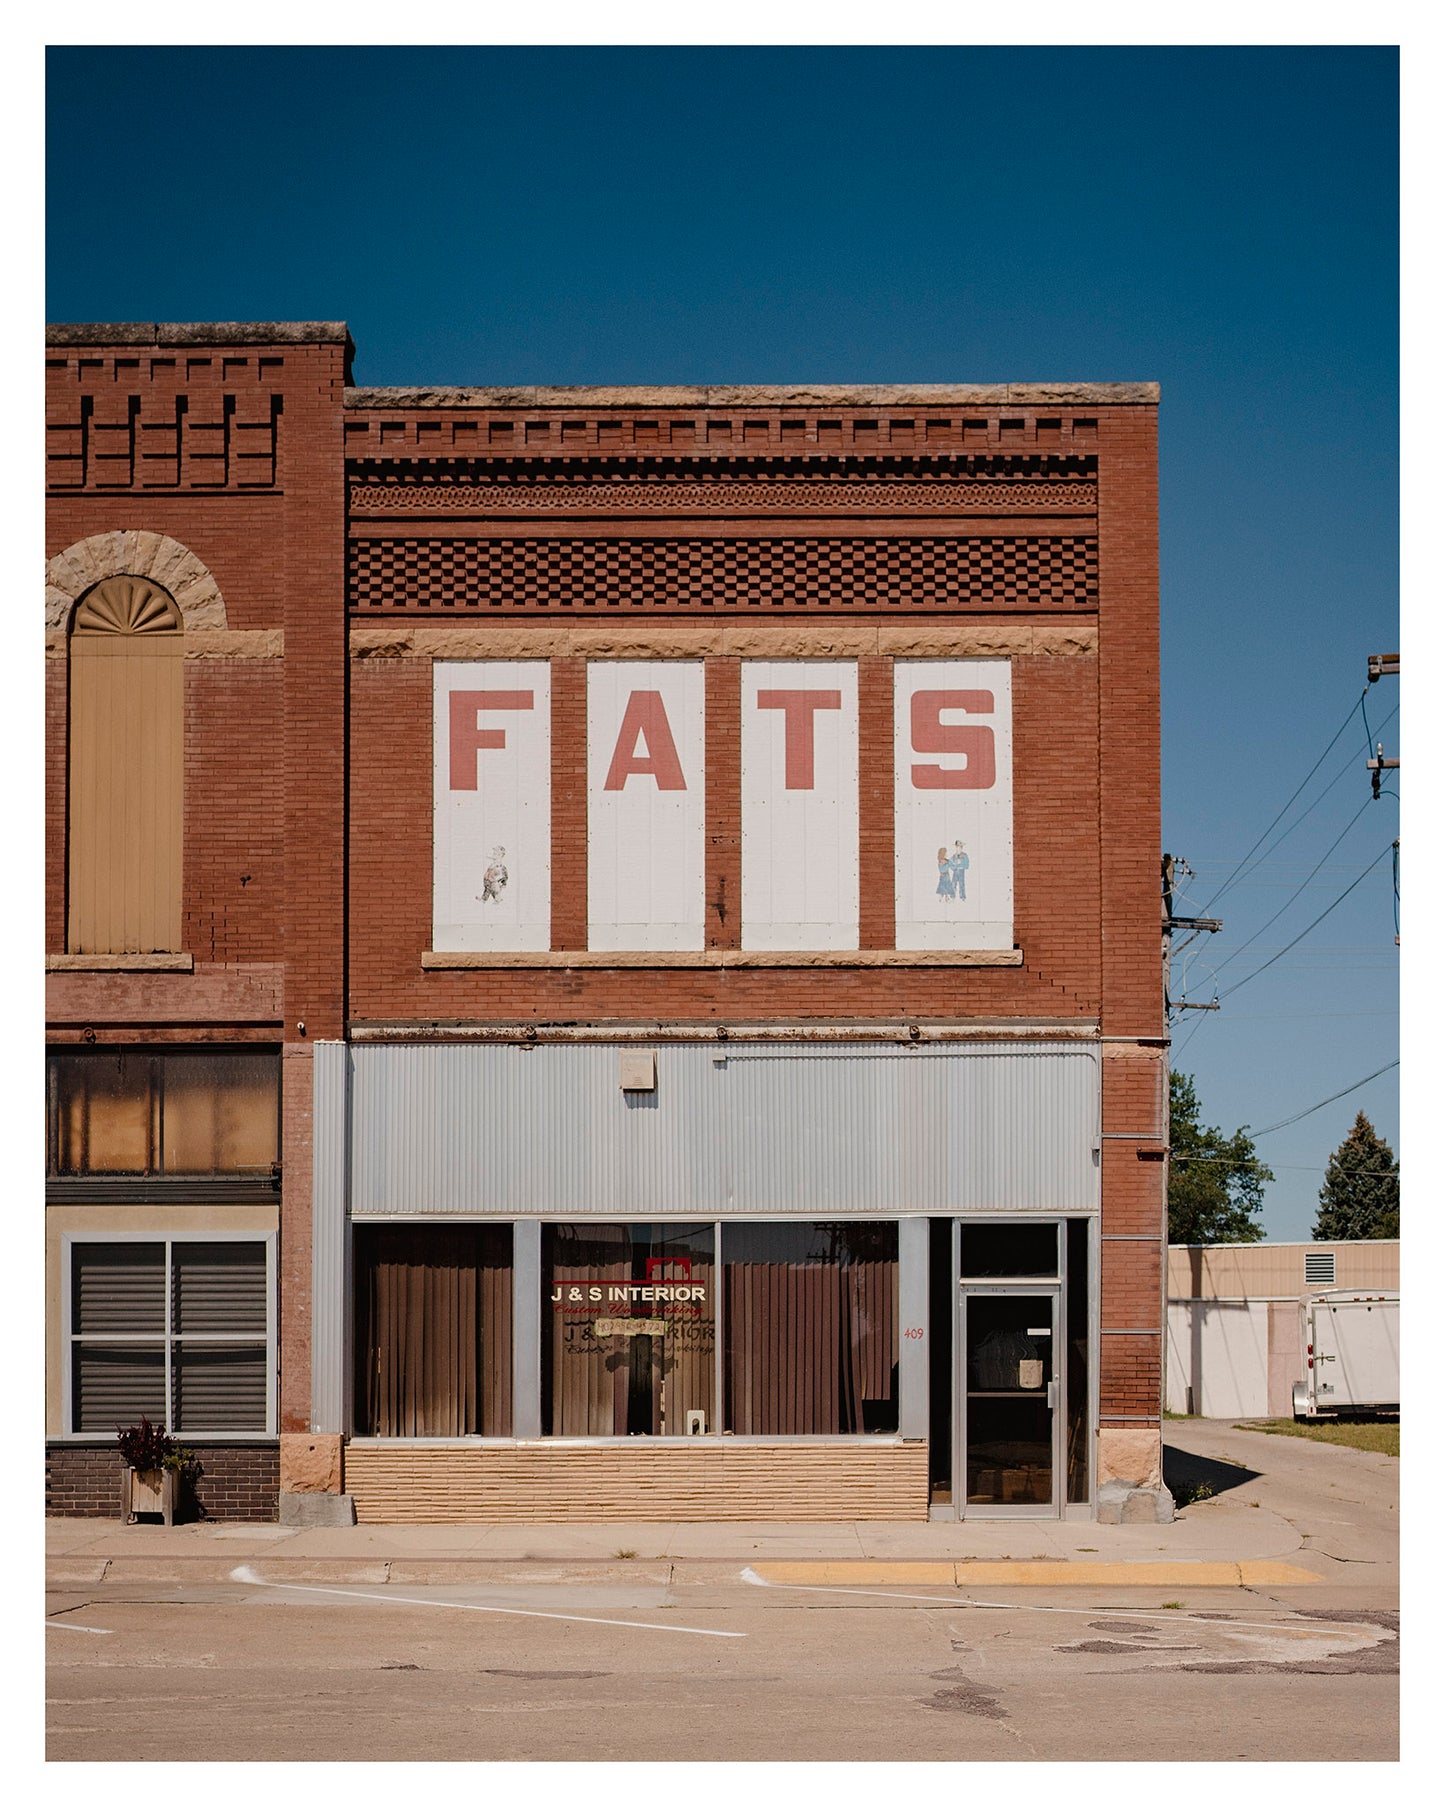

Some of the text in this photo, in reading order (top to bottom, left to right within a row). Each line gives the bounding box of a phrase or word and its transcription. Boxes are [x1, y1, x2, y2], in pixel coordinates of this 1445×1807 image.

[449, 690, 996, 790] FATS
[551, 1287, 706, 1301] J & S INTERIOR
[553, 1303, 604, 1314] Custom
[904, 1328, 924, 1339] 409
